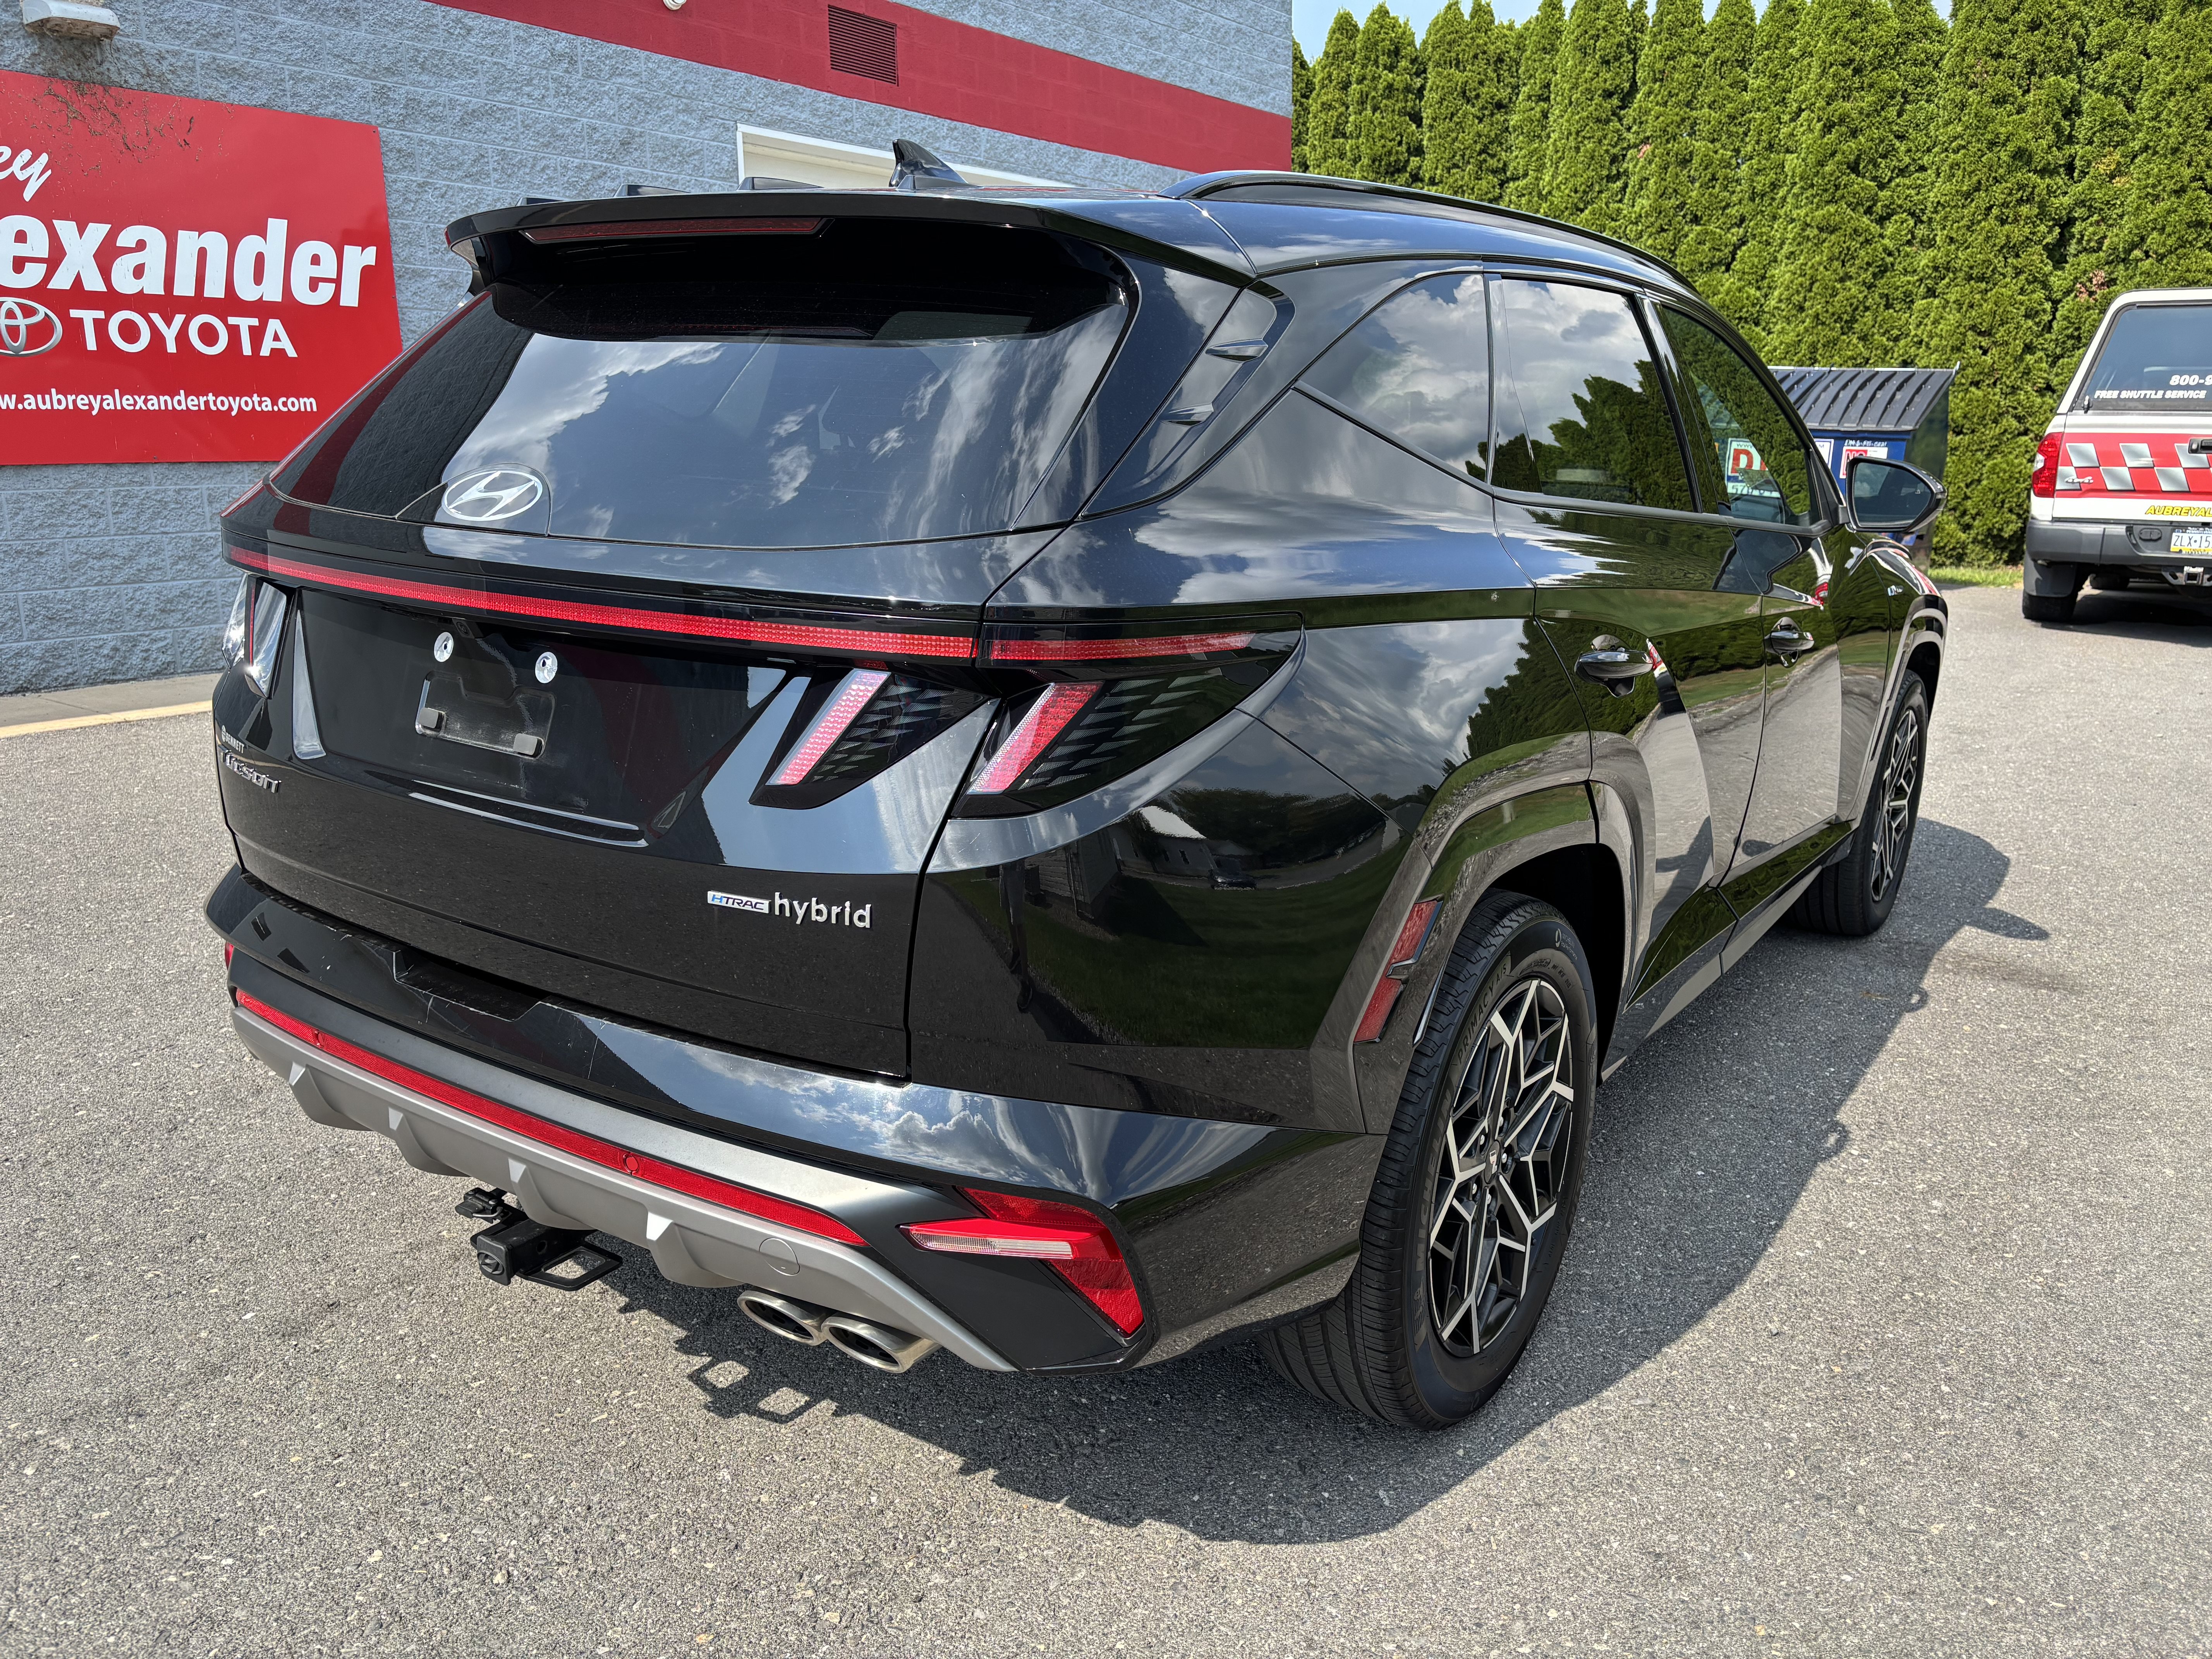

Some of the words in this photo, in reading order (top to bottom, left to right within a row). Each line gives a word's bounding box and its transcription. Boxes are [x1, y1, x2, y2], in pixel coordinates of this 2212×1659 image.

[0, 146, 52, 202] ey
[0, 215, 376, 307] exander
[69, 309, 298, 357] TOYOTA
[0, 388, 317, 416] w.aubreyalexandertoyota.com
[2094, 390, 2119, 398] FREE
[2120, 390, 2164, 398] SHUTTLE
[2164, 390, 2207, 398] SERVICE
[2145, 505, 2212, 517] AUBREYAL
[226, 732, 245, 754] BENNETT
[711, 894, 765, 911] HTRAC
[775, 892, 872, 928] hybrid
[1458, 980, 1494, 1065] PRIMACY
[1416, 1089, 1452, 1271] MICHELIN
